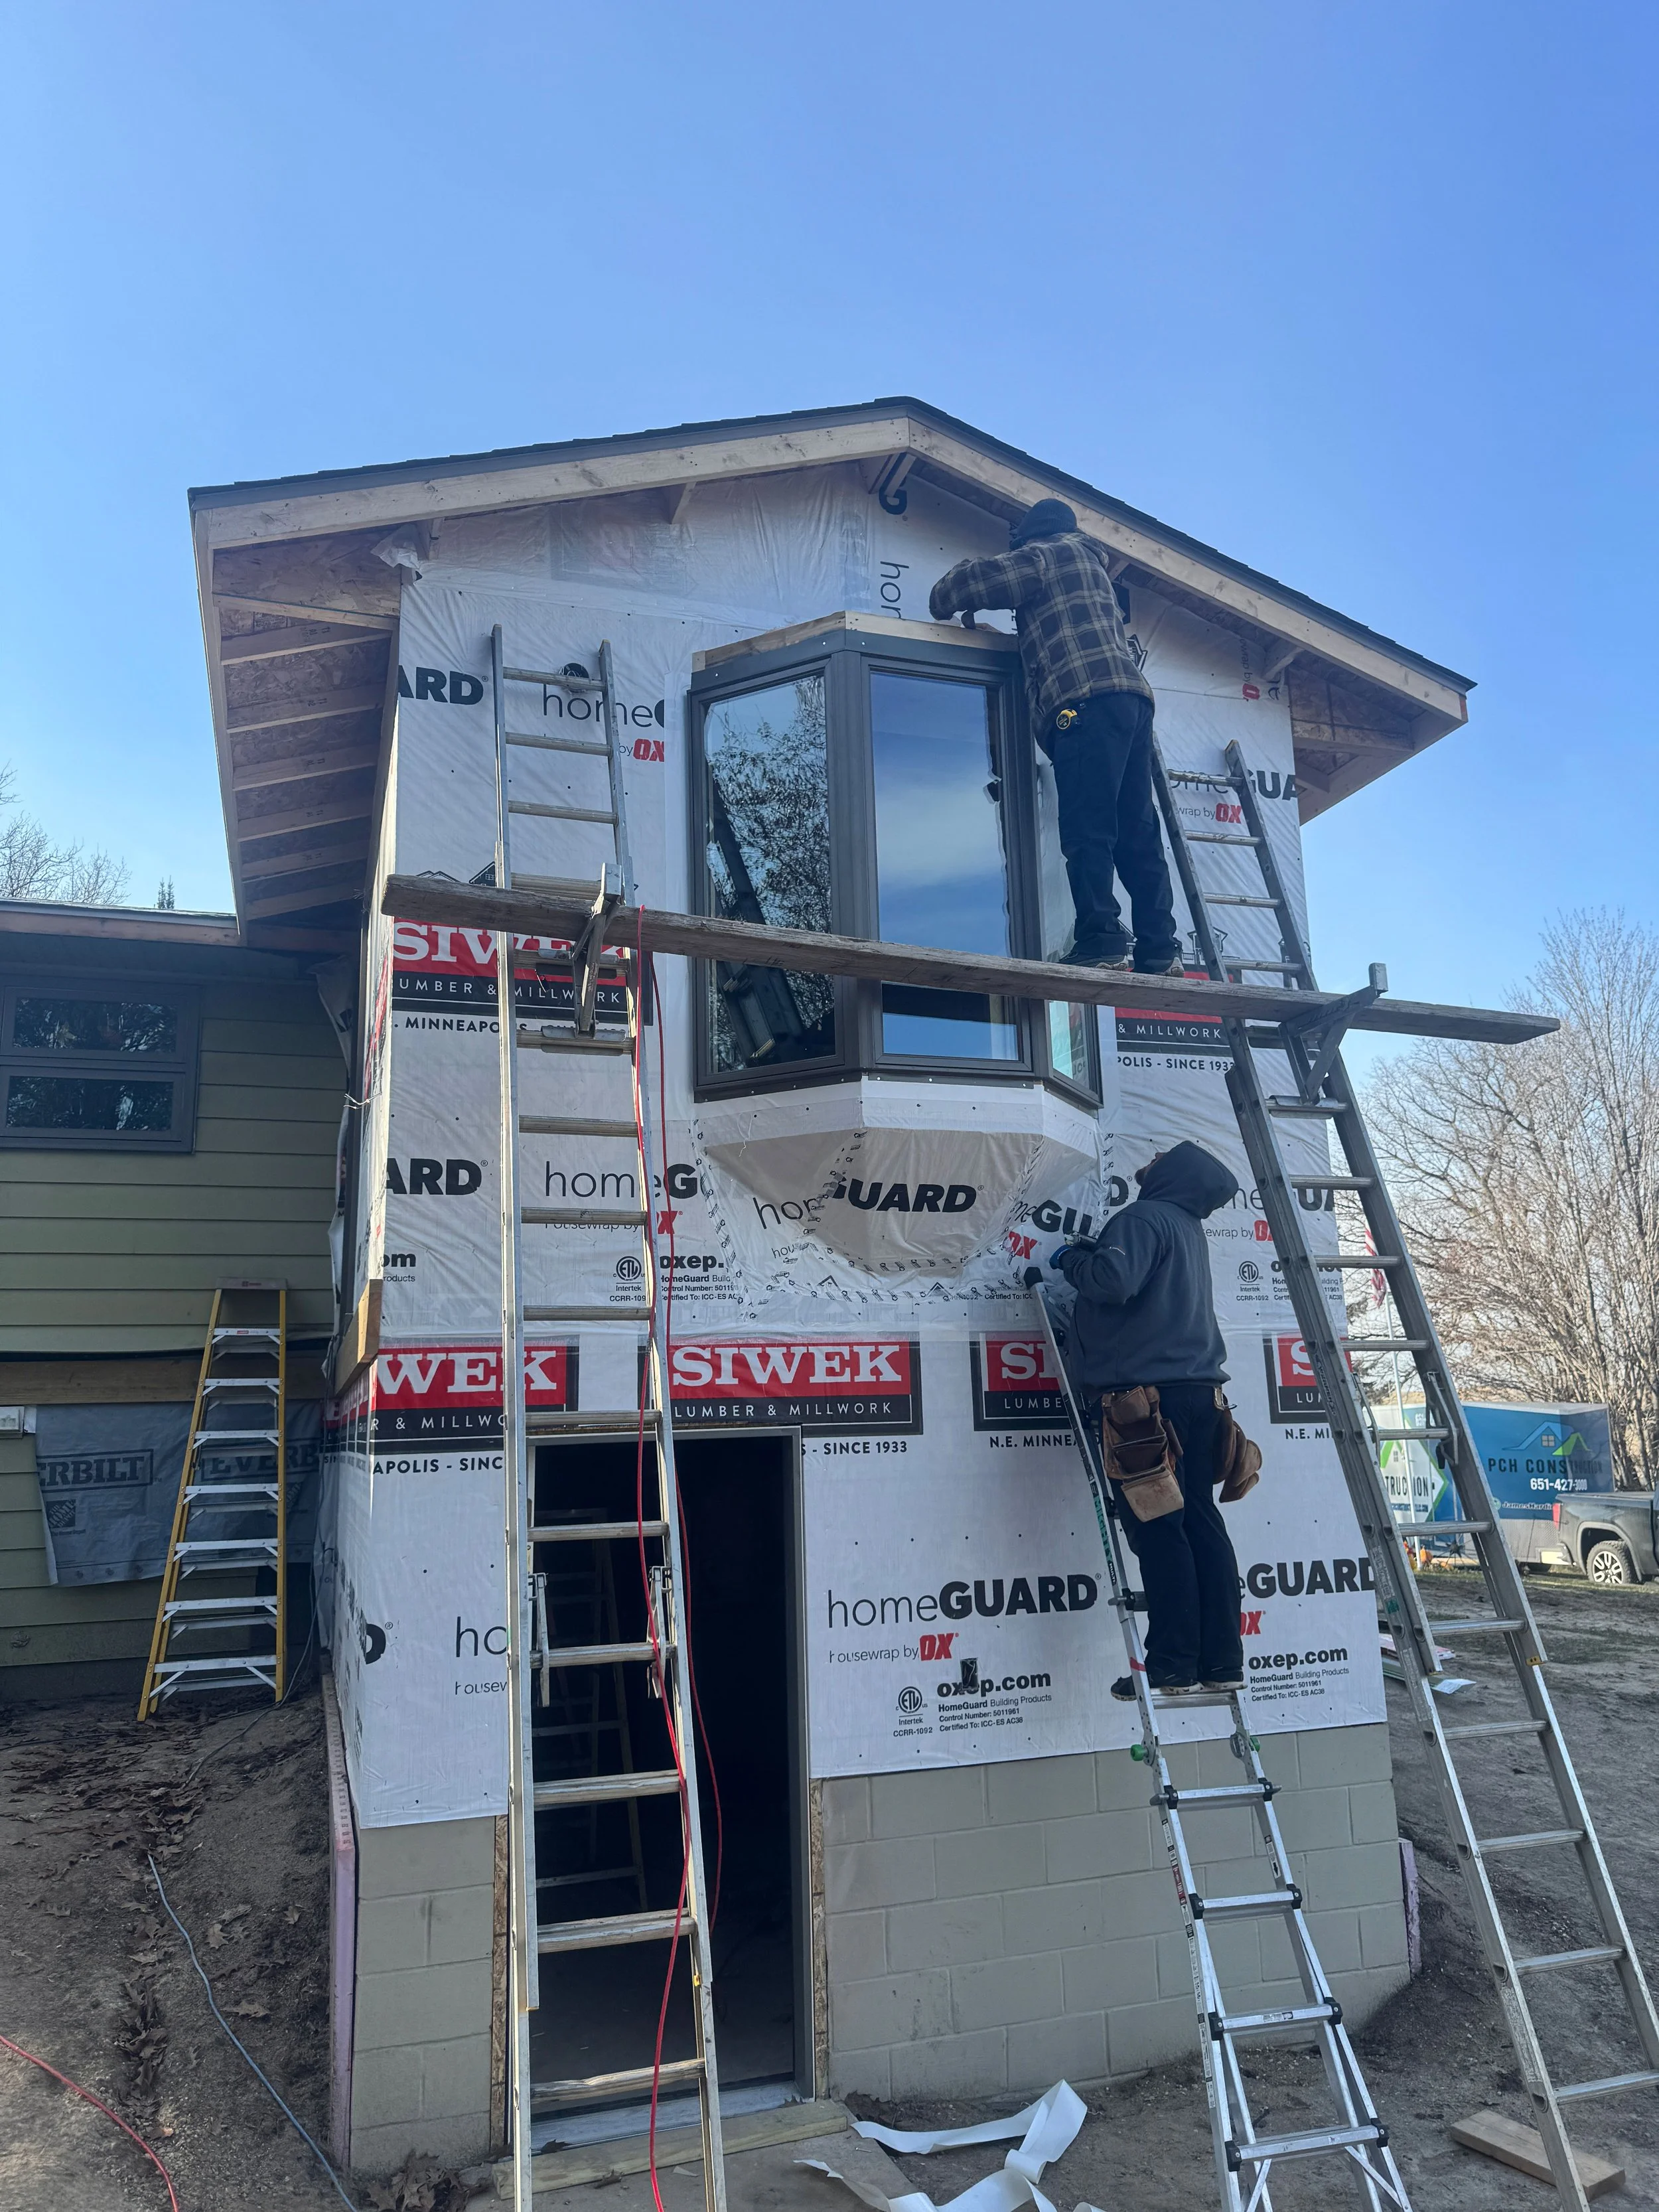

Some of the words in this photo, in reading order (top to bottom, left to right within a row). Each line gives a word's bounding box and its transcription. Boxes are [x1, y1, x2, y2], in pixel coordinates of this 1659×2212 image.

[1204, 807, 1215, 820] by
[1216, 803, 1242, 824] OX
[399, 978, 472, 993] UMBER
[515, 986, 620, 1003] MILLWRK
[1118, 1023, 1126, 1033] &
[1137, 1025, 1221, 1039] MILLWORK
[1167, 1058, 1205, 1070] SINCE
[1242, 1227, 1254, 1240] by
[672, 1345, 902, 1386] SIWEK
[674, 1404, 755, 1418] LUMBER
[767, 1405, 776, 1416] &
[789, 1402, 891, 1416] MILLWORK
[396, 1418, 405, 1429] &
[1285, 1428, 1310, 1439] N.E.
[824, 1441, 871, 1455] SINCE
[875, 1440, 907, 1453] 1933
[989, 1436, 1017, 1448] N.E.
[372, 1459, 439, 1474] APOLIS
[459, 1456, 502, 1471] SINC
[1488, 1458, 1518, 1473] PCH
[828, 1574, 1098, 1628] homeGUARD
[903, 1644, 918, 1661] by
[919, 1632, 954, 1661] OX
[1248, 1647, 1348, 1670] oxep.com
[1250, 1672, 1293, 1684] HomeGuard
[1295, 1670, 1321, 1680] Building
[1322, 1667, 1349, 1676] Products
[936, 1672, 1052, 1698] oxp.com
[1251, 1684, 1272, 1693] Control
[1273, 1682, 1297, 1691] Number:
[1298, 1680, 1322, 1688] 5011961
[938, 1700, 988, 1713] HomeGuard
[990, 1696, 1019, 1708] Building
[1021, 1694, 1052, 1704] Products
[1252, 1693, 1277, 1702] Certified
[1288, 1689, 1309, 1698] ICC-ES
[899, 1717, 923, 1726] Intertek
[939, 1714, 963, 1723] Control
[965, 1711, 992, 1721] Number:
[993, 1708, 1020, 1717] 5011961
[893, 1726, 933, 1737] CCRR-1092
[940, 1723, 968, 1732] Certified
[981, 1719, 1005, 1728] ICC-ES
[1006, 1716, 1023, 1726] AC38
